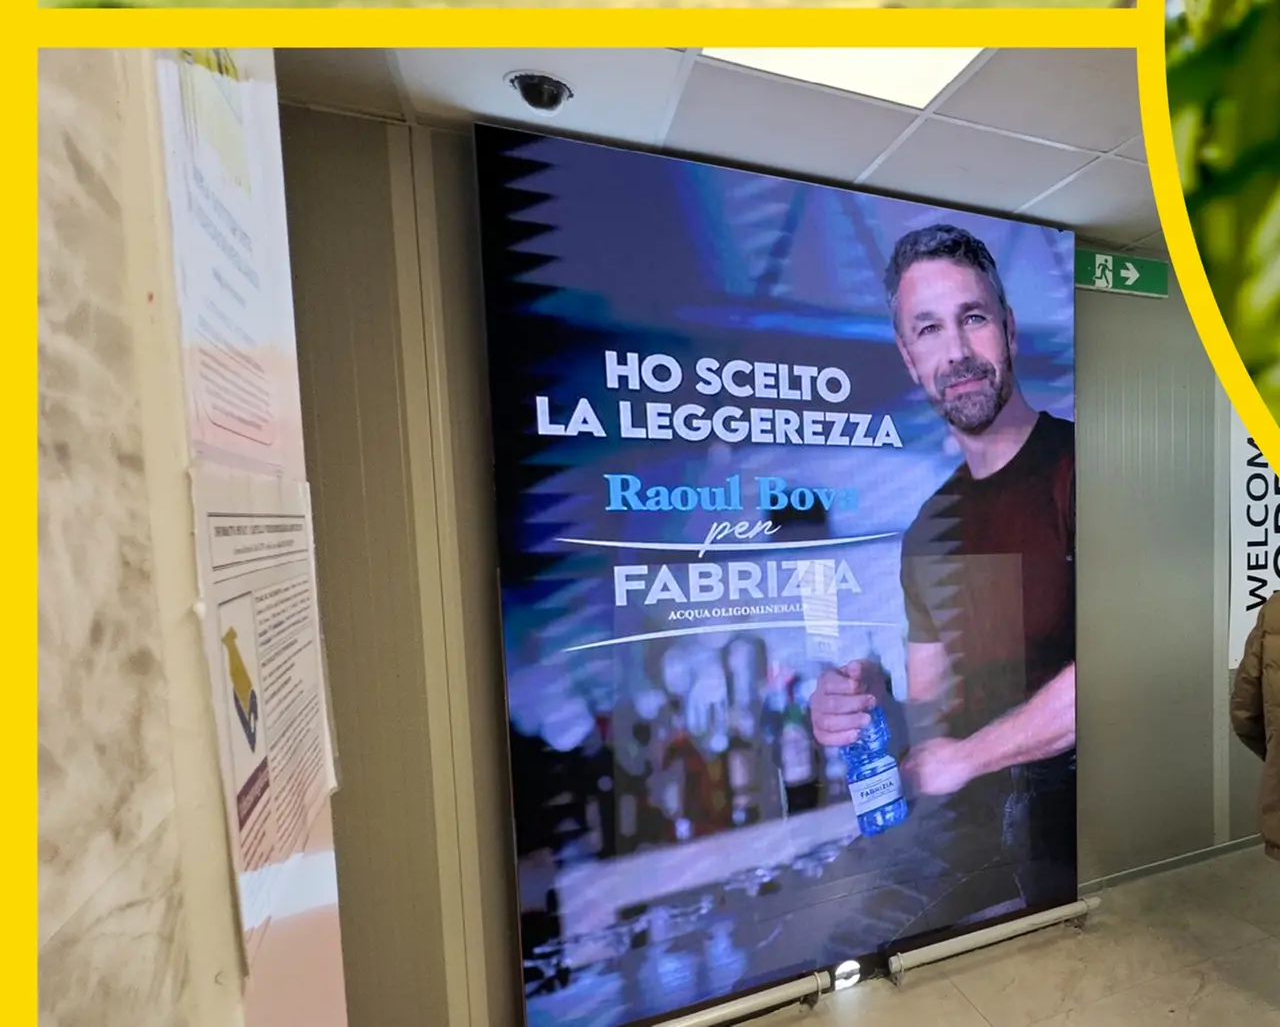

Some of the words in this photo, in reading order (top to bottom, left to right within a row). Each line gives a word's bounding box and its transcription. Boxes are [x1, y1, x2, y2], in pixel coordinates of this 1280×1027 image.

[605, 350, 683, 393] HO
[694, 356, 851, 403] SCELTO
[535, 396, 606, 438] LA
[619, 402, 904, 448] LEGGEREZZA
[604, 473, 743, 513] Raoul
[754, 476, 859, 513] Bova
[698, 519, 783, 557] per
[613, 558, 862, 607] FABRIZIA
[668, 609, 710, 620] ACQUA
